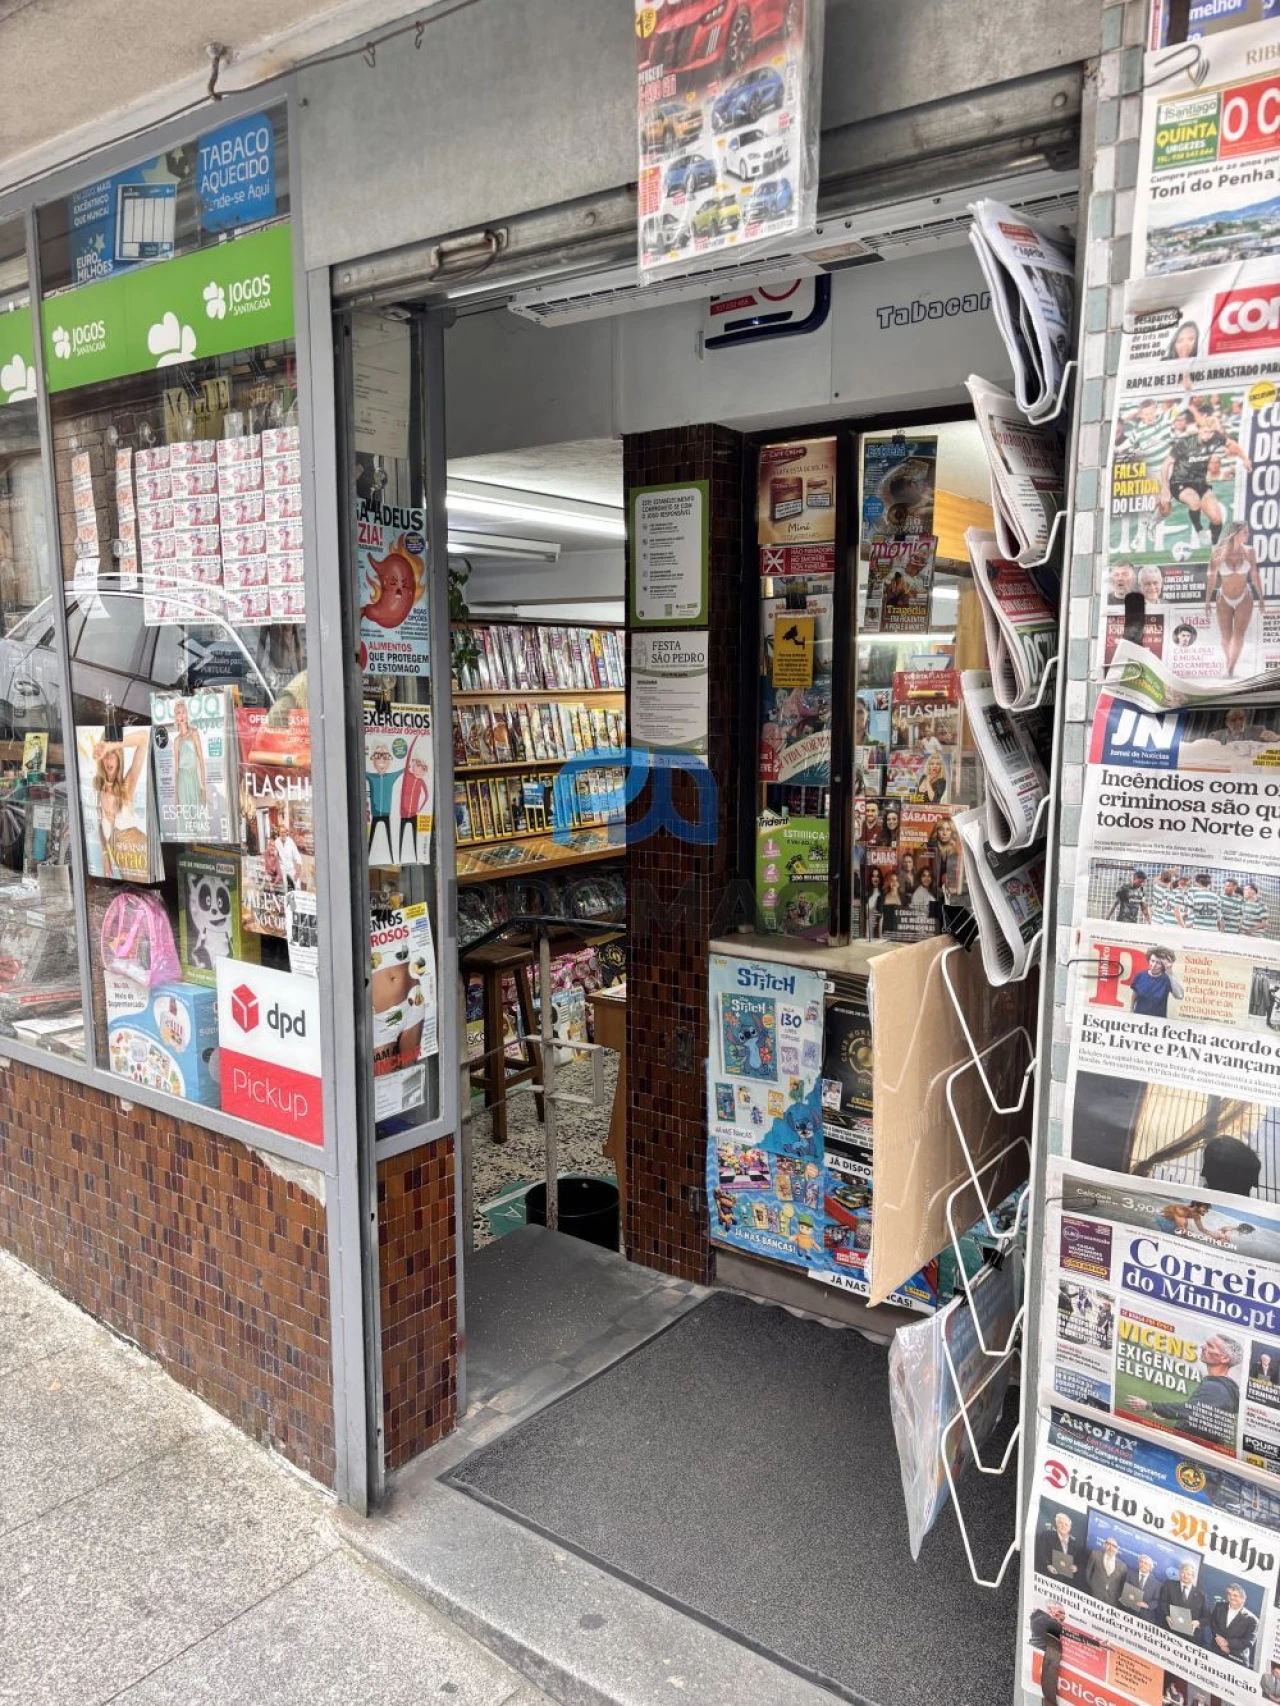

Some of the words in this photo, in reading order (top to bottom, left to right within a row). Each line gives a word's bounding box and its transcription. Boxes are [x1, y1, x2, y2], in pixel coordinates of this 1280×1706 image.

[1223, 97, 1248, 142] O
[1156, 122, 1217, 148] QUINTA
[200, 127, 270, 171] TABACO
[201, 155, 270, 194] AQUECIDO
[1150, 171, 1184, 184] Cumpre
[1187, 168, 1209, 179] pena
[1239, 158, 1261, 168] anos
[247, 179, 270, 203] Aqui
[1150, 182, 1185, 200] Toni
[1189, 178, 1212, 192] do
[73, 193, 109, 214] EXCÊNTRICO
[73, 215, 87, 231] QUE
[86, 206, 110, 222] NUNCA!
[77, 259, 113, 283] MILHÕES
[228, 273, 271, 313] JOGOS
[72, 319, 106, 353] JOGOS
[1126, 375, 1152, 389] RAPAZ
[1154, 375, 1165, 387] DE
[1167, 374, 1177, 385] 13
[1207, 364, 1258, 380] ARRASTADO
[1114, 461, 1146, 480] FALSA
[1113, 478, 1159, 497] PARTIDA
[1112, 499, 1127, 514] DO
[1128, 495, 1155, 512] LEÃO
[788, 522, 810, 533] Mini
[871, 540, 930, 559] maria
[1180, 615, 1211, 626] Vidas
[368, 640, 413, 653] ALIMENTOS
[652, 640, 682, 651] FESTA
[368, 652, 385, 665] QUE
[386, 653, 430, 666] PROTEGEM
[369, 663, 376, 673] O
[377, 661, 421, 675] ESTÔMAGO
[651, 651, 670, 664] SÃO
[672, 652, 705, 664] PEDRO
[899, 703, 951, 719] FLASH!
[365, 725, 380, 736] para
[381, 725, 403, 736] afastar
[404, 727, 430, 738] doenças
[1111, 709, 1179, 750] JN
[1109, 748, 1129, 758] Jornal
[1131, 750, 1140, 759] de
[1141, 750, 1170, 760] Notícias
[1101, 770, 1204, 792] Incêndios
[1209, 781, 1258, 796] com
[163, 804, 213, 820] ESPECIAL
[1098, 792, 1206, 813] criminosa
[1211, 799, 1250, 816] são
[757, 816, 789, 828] Trident
[1096, 811, 1154, 831] todos
[1159, 818, 1186, 832] no
[1190, 817, 1254, 838] Norte
[1259, 826, 1272, 839] e
[871, 851, 897, 866] CARAS
[1183, 964, 1220, 977] Estudos
[1184, 955, 1213, 966] Saúde
[1183, 975, 1223, 988] apontam
[1224, 982, 1246, 993] para
[1185, 985, 1218, 999] relação
[1220, 990, 1245, 1000] entre
[1192, 996, 1215, 1007] calor
[266, 1002, 306, 1039] dpd
[780, 1012, 802, 1028] 130
[1179, 1006, 1233, 1019] enxaquecas
[1083, 1013, 1158, 1037] Esquerda
[1161, 1023, 1206, 1045] fecha
[1210, 1032, 1267, 1055] acordo
[1080, 1030, 1105, 1046] BE,
[1109, 1033, 1150, 1054] Livre
[1154, 1044, 1164, 1054] e
[1166, 1042, 1200, 1061] PAN
[233, 1067, 308, 1122] Pickup
[829, 1155, 841, 1167] JÁ
[1076, 1187, 1112, 1202] Calções
[744, 1231, 760, 1244] NAS
[1129, 1238, 1280, 1304] Correio
[830, 1273, 843, 1286] JÁ
[844, 1275, 867, 1293] NAS
[1126, 1271, 1155, 1292] do
[1163, 1278, 1276, 1331] Minho.pt
[1119, 1319, 1197, 1363] VICENS
[1118, 1340, 1202, 1383] EXIGÊNCIA
[1117, 1356, 1188, 1395] ELEVADA
[1043, 1460, 1137, 1518] Diário
[1142, 1505, 1165, 1529] do
[1170, 1509, 1274, 1572] Minho
[1033, 1572, 1105, 1611] Investimento
[1106, 1604, 1121, 1618] de
[1136, 1618, 1183, 1648] milhões
[1184, 1643, 1209, 1661] cria
[1033, 1584, 1080, 1613] terminal
[1082, 1603, 1170, 1654] rodoferroviário
[1172, 1646, 1191, 1662] em
[1193, 1655, 1258, 1695] Famalicão
